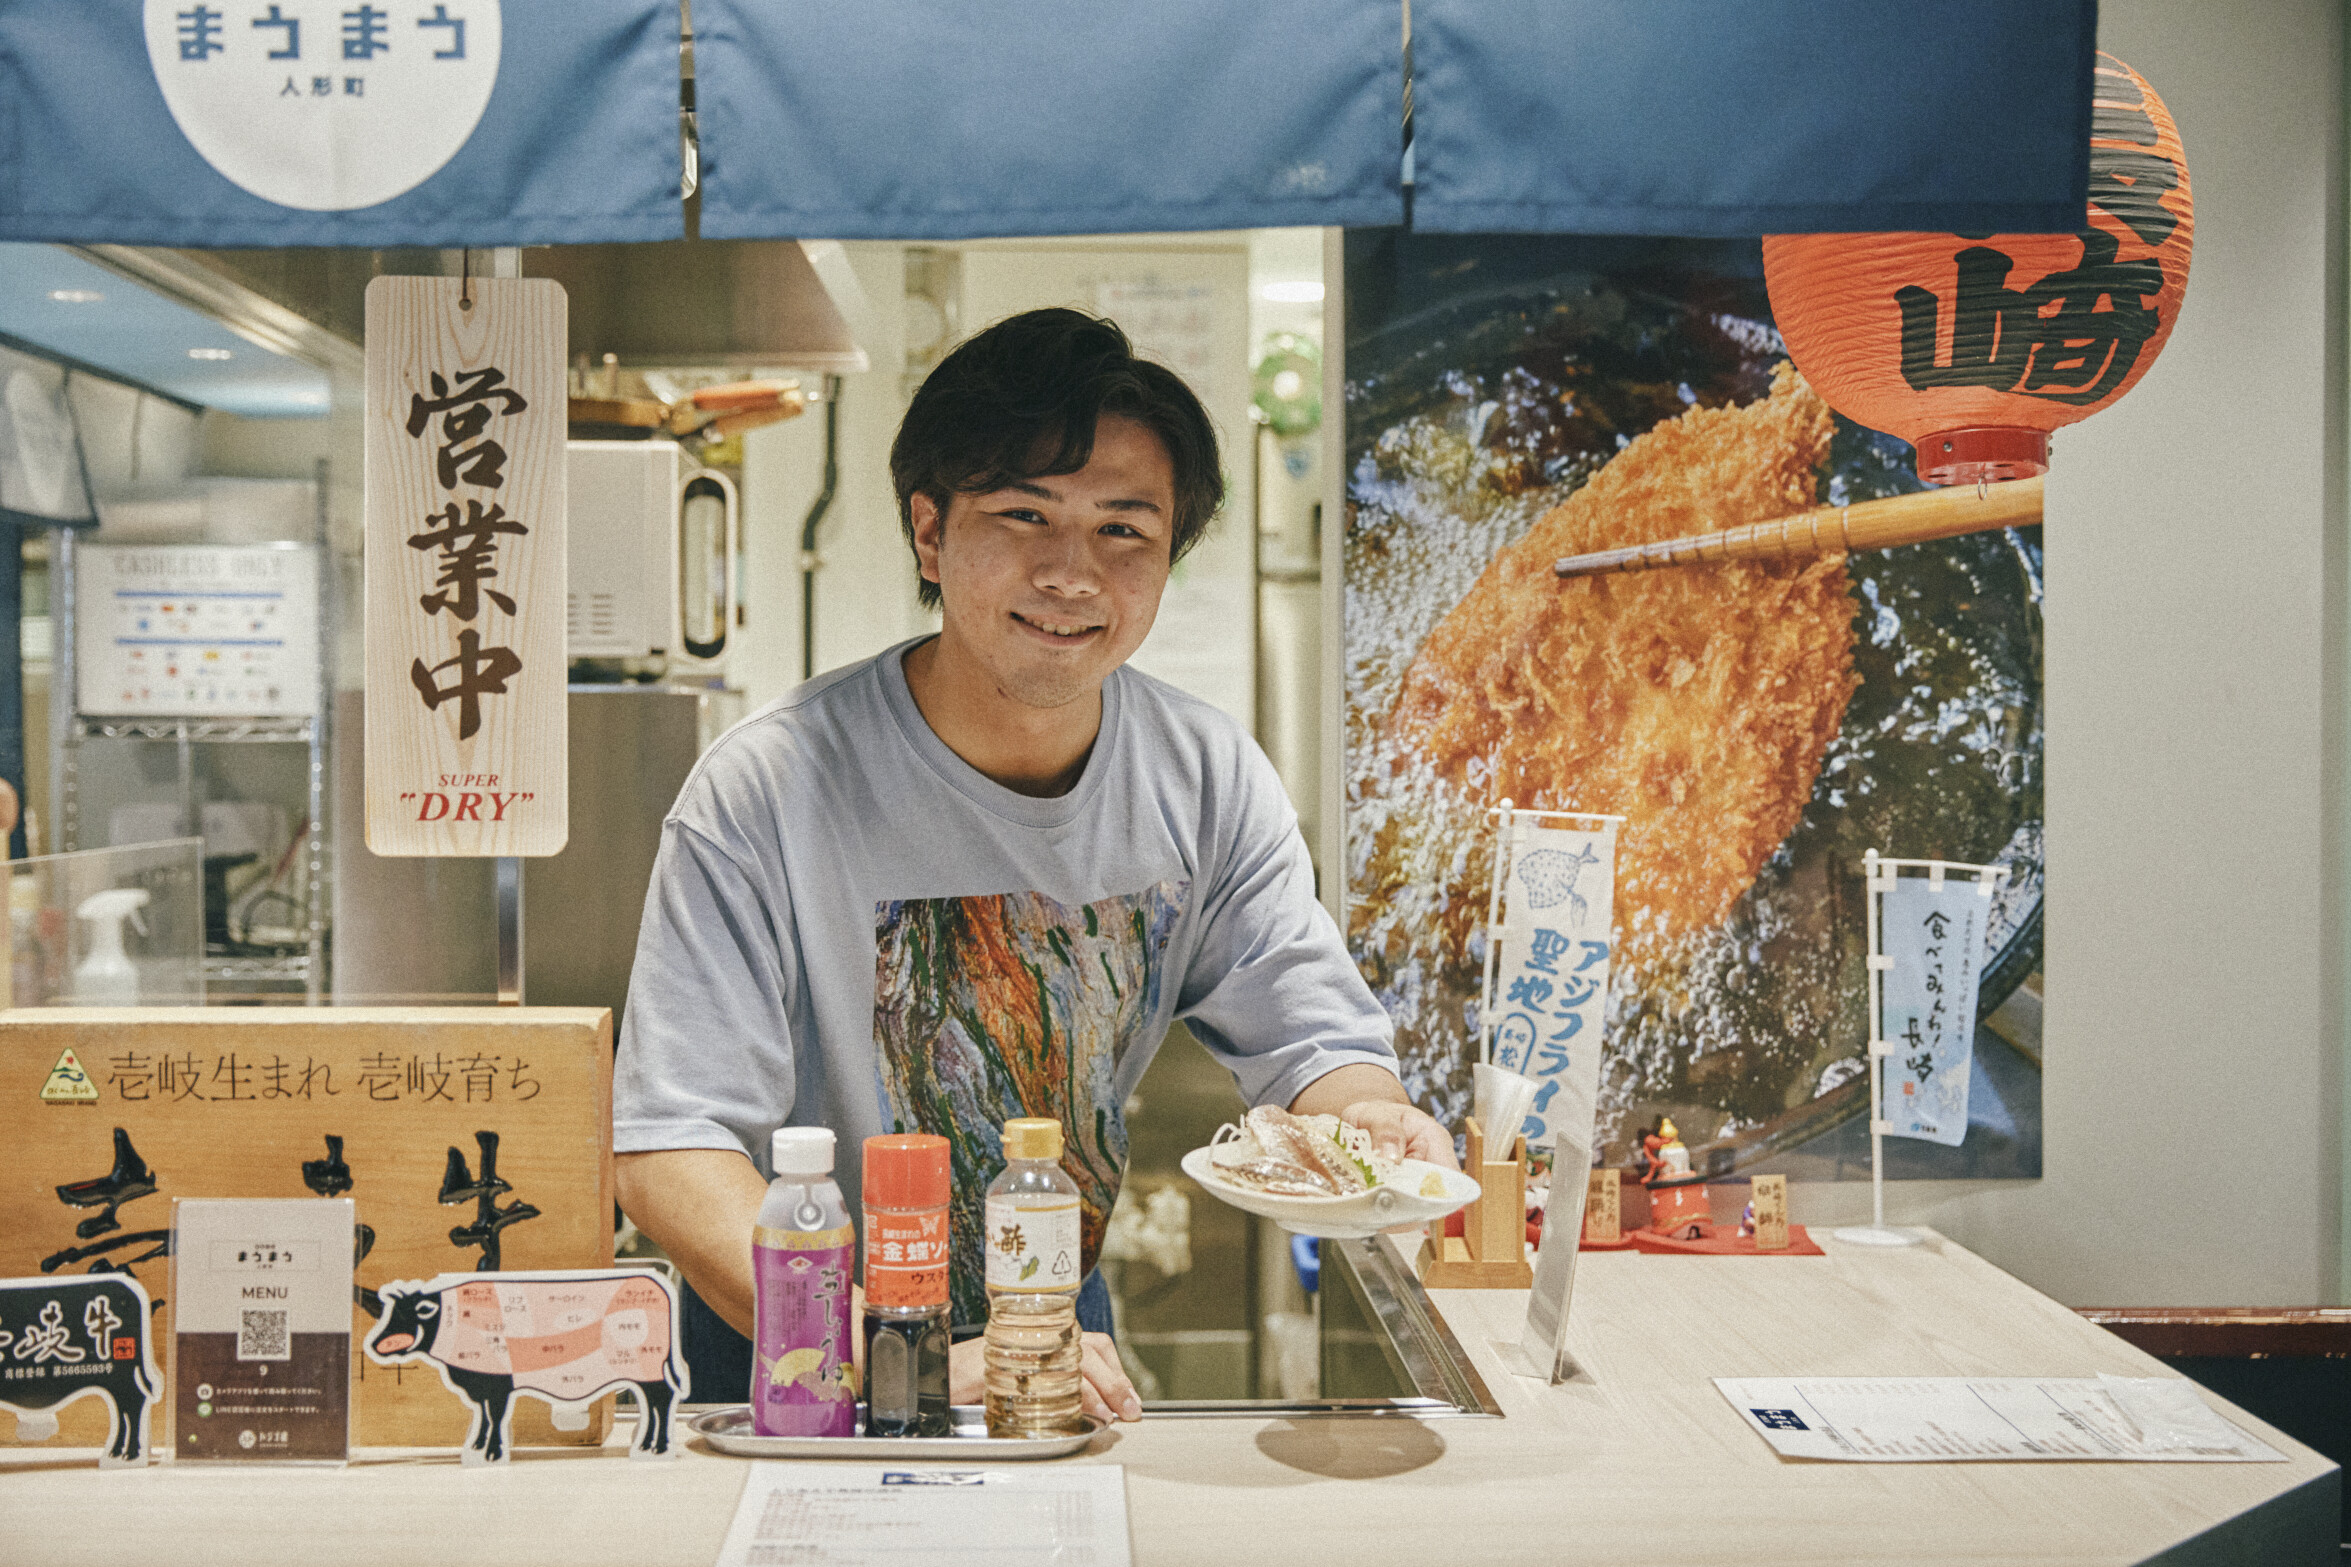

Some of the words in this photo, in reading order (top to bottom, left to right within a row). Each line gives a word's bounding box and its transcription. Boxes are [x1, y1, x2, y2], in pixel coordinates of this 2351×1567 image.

[177, 4, 466, 61] まうまう
[280, 76, 366, 98] 人形町
[406, 366, 528, 740] 営業中
[438, 773, 499, 787] SUPER
[1506, 928, 1570, 1014] 聖地
[107, 1050, 341, 1102] 壱岐生まれ
[357, 1050, 542, 1103] 壱岐育ち
[242, 1287, 289, 1299] MENU
